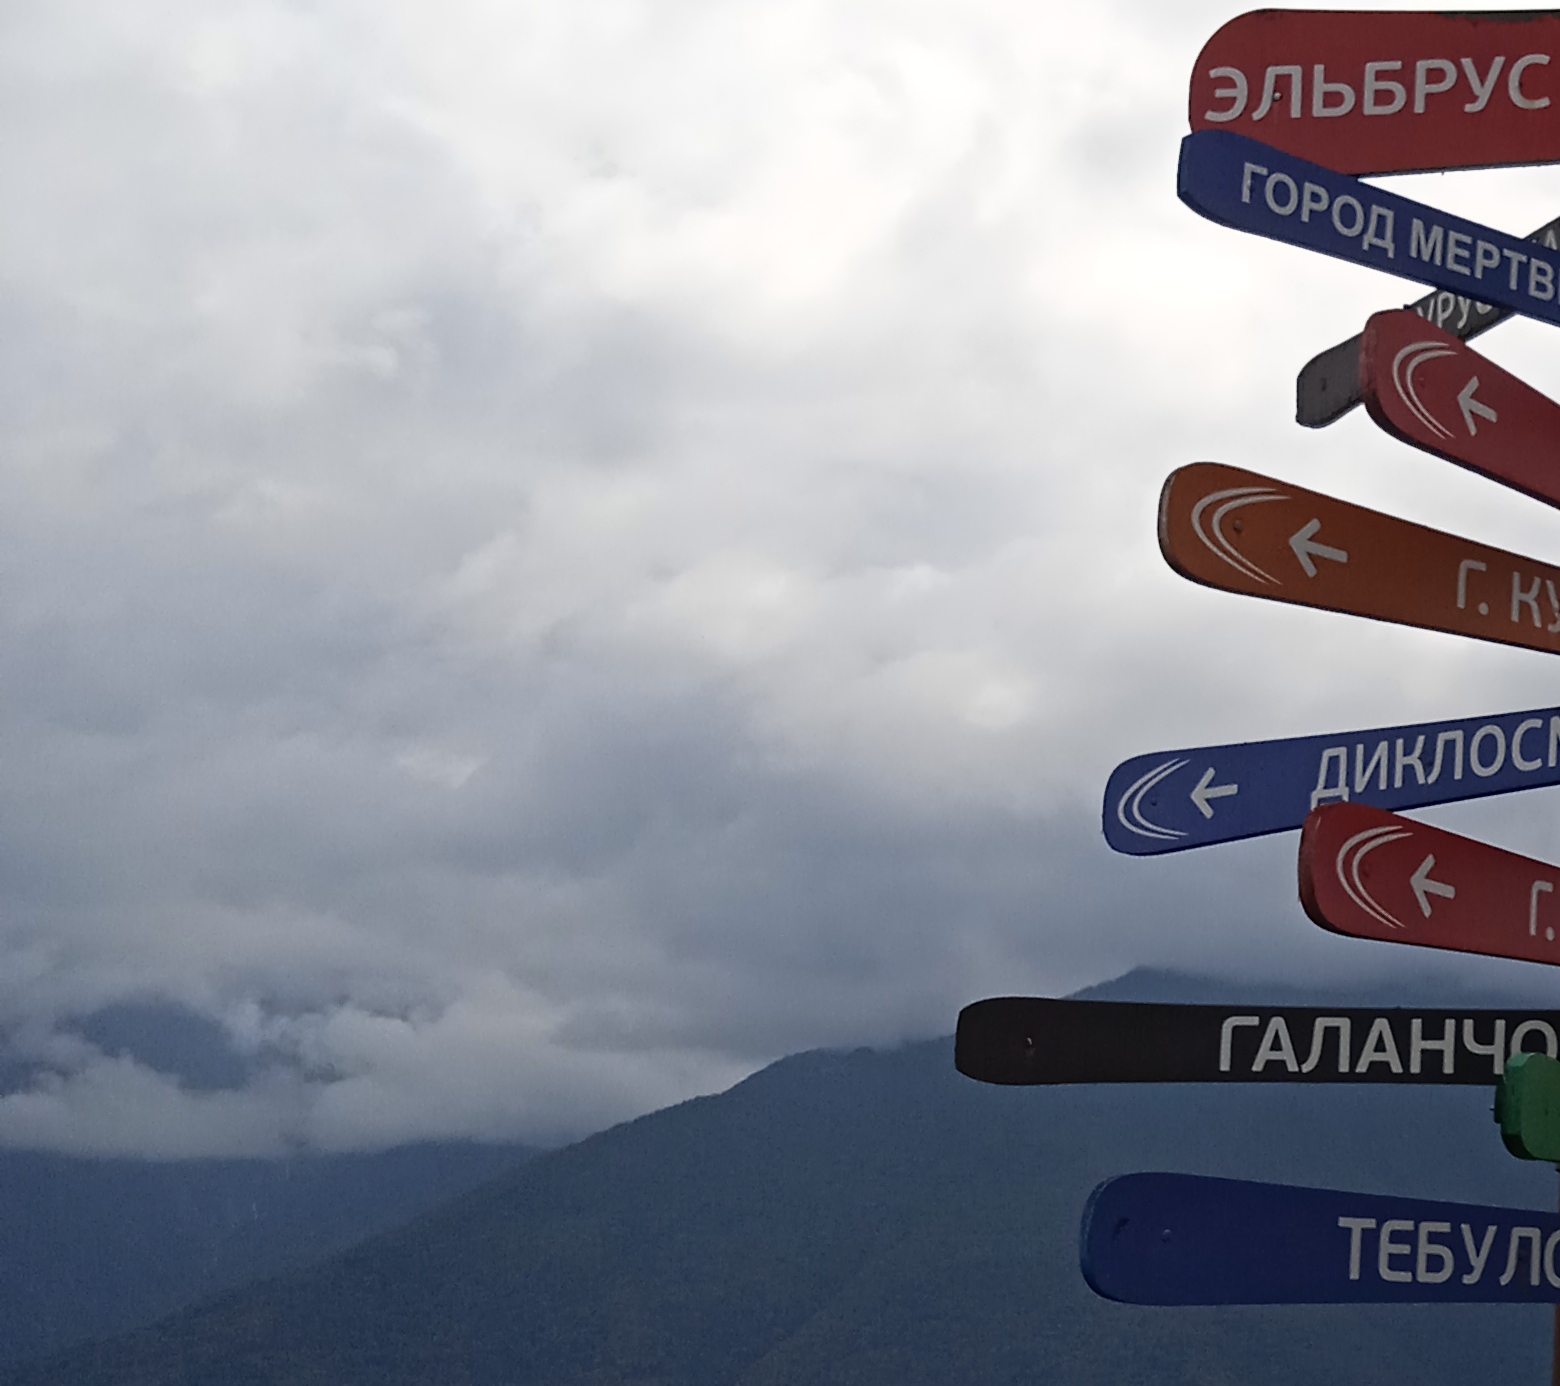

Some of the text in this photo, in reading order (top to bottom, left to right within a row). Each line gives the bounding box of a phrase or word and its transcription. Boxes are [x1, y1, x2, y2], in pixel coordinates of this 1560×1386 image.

[1204, 53, 1551, 123] ЭЛЬБРУС
[1241, 162, 1396, 259] ГОРОД
[1456, 559, 1490, 616] Г.
[1528, 879, 1556, 942] Г.
